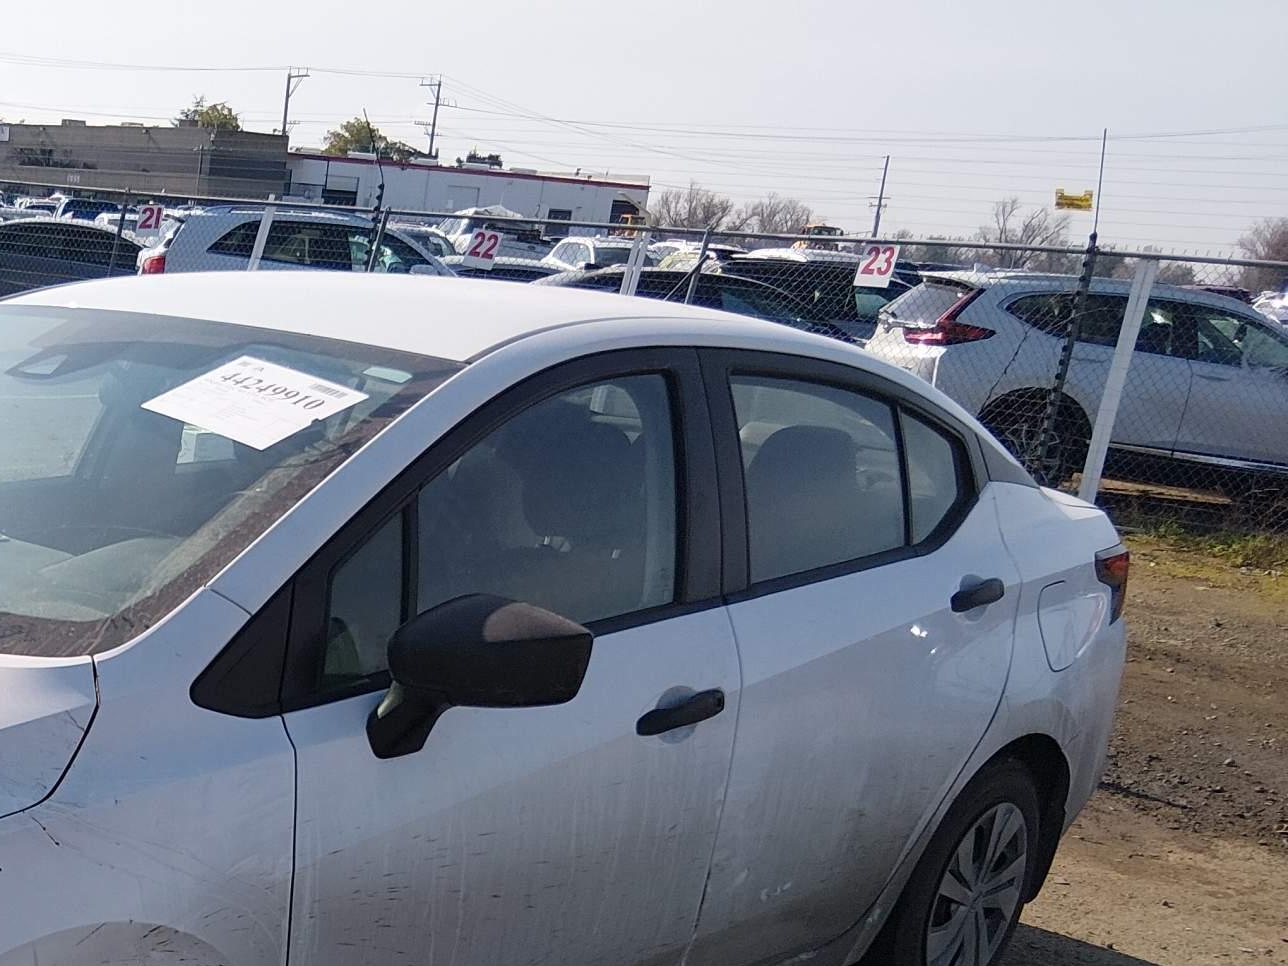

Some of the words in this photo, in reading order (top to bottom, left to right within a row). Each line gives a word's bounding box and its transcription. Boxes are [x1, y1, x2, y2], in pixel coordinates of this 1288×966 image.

[138, 207, 163, 230] 21
[467, 231, 499, 260] 22
[860, 246, 895, 276] 23
[220, 372, 326, 410] 44249910
